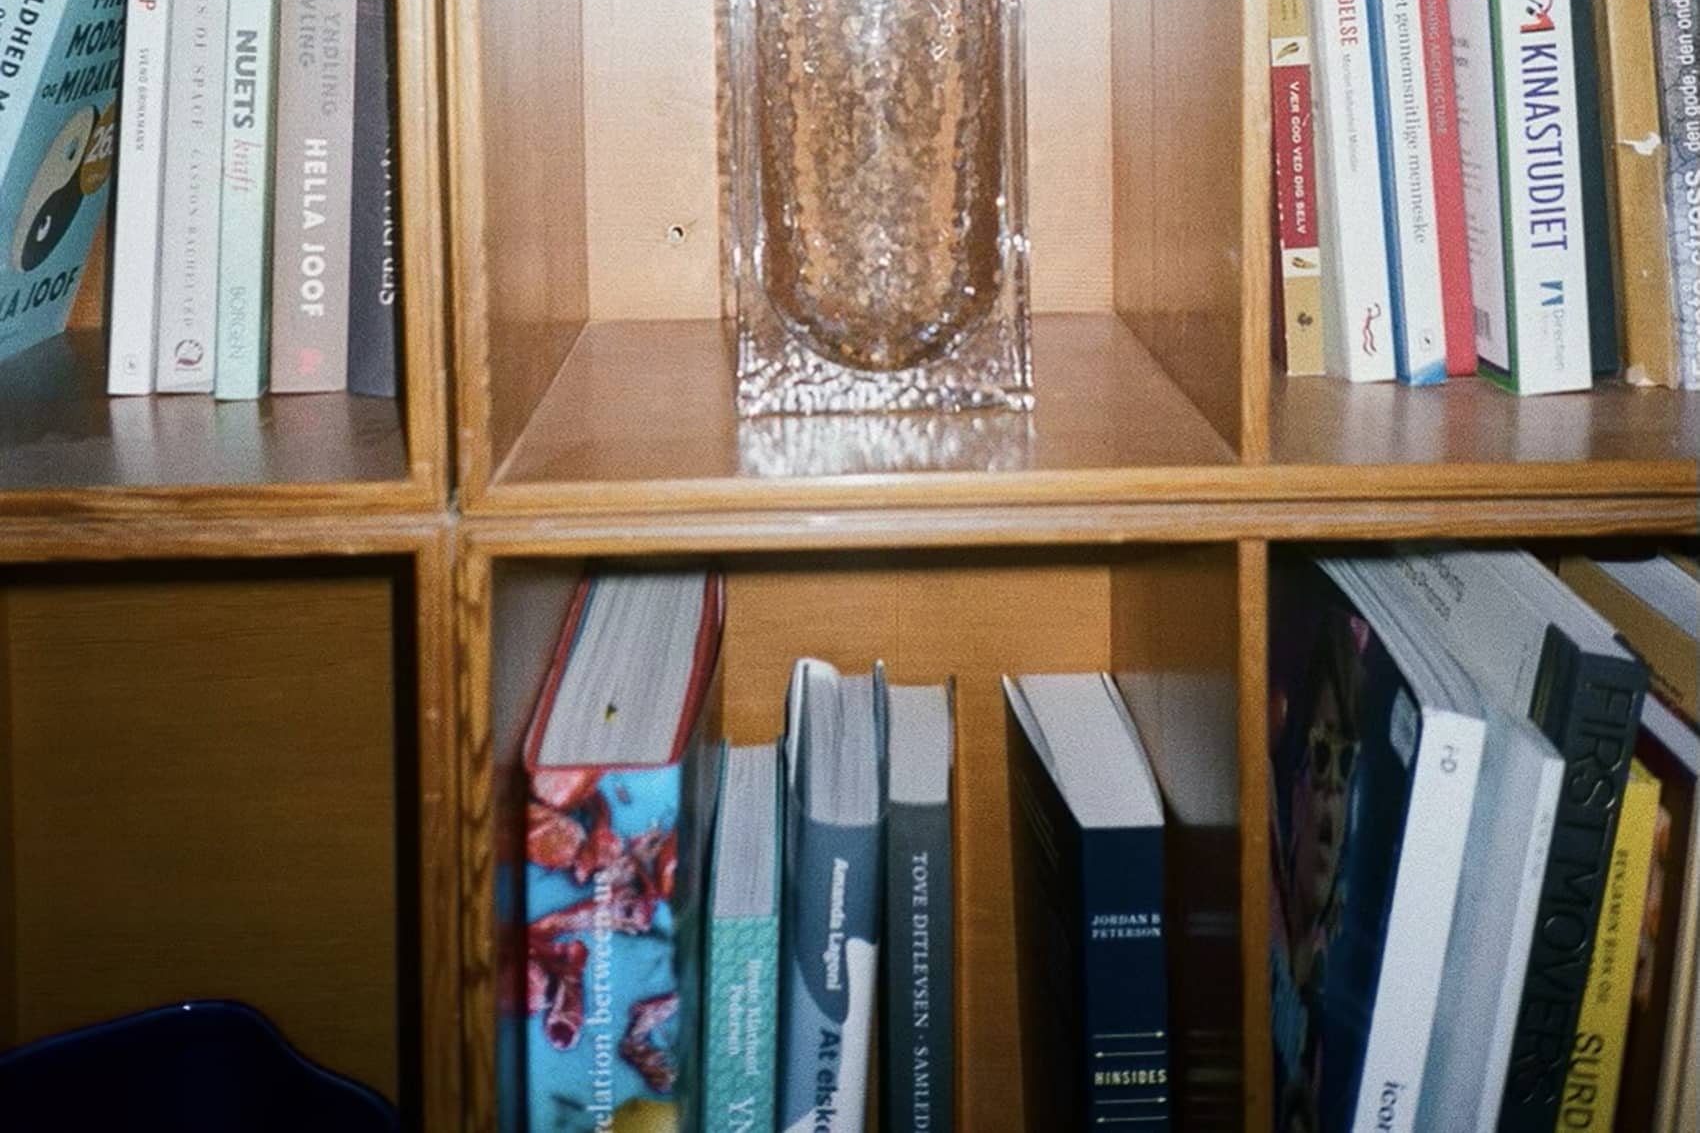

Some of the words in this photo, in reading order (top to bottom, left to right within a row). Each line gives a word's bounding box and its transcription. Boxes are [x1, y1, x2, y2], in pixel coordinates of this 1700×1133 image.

[195, 29, 206, 48] OF
[321, 13, 342, 116] YNDLING
[1679, 33, 1694, 65] den
[191, 67, 205, 127] SPACE
[232, 30, 258, 130] NUETS
[1289, 81, 1301, 113] VÆR
[1397, 10, 1421, 150] gennemsnitlige
[1409, 153, 1427, 244] menneske
[1520, 44, 1568, 251] KINASTUDIET
[1684, 119, 1700, 153] den
[303, 138, 328, 229] HELLA
[1292, 146, 1304, 173] VED
[1294, 201, 1306, 235] SELV
[22, 266, 79, 313] JOOF
[301, 243, 326, 317] JOOF
[1560, 683, 1638, 852] FIRST
[830, 857, 849, 930] Amanda
[912, 852, 928, 907] TOVE
[1091, 914, 1148, 927] JORDAN
[1092, 927, 1162, 939] PETERSON
[586, 912, 613, 1025] between
[912, 914, 929, 1028] DITLEVSEN
[818, 1026, 841, 1061] At
[914, 1046, 930, 1133] SAMLED
[1094, 1069, 1168, 1086] HINSIDES
